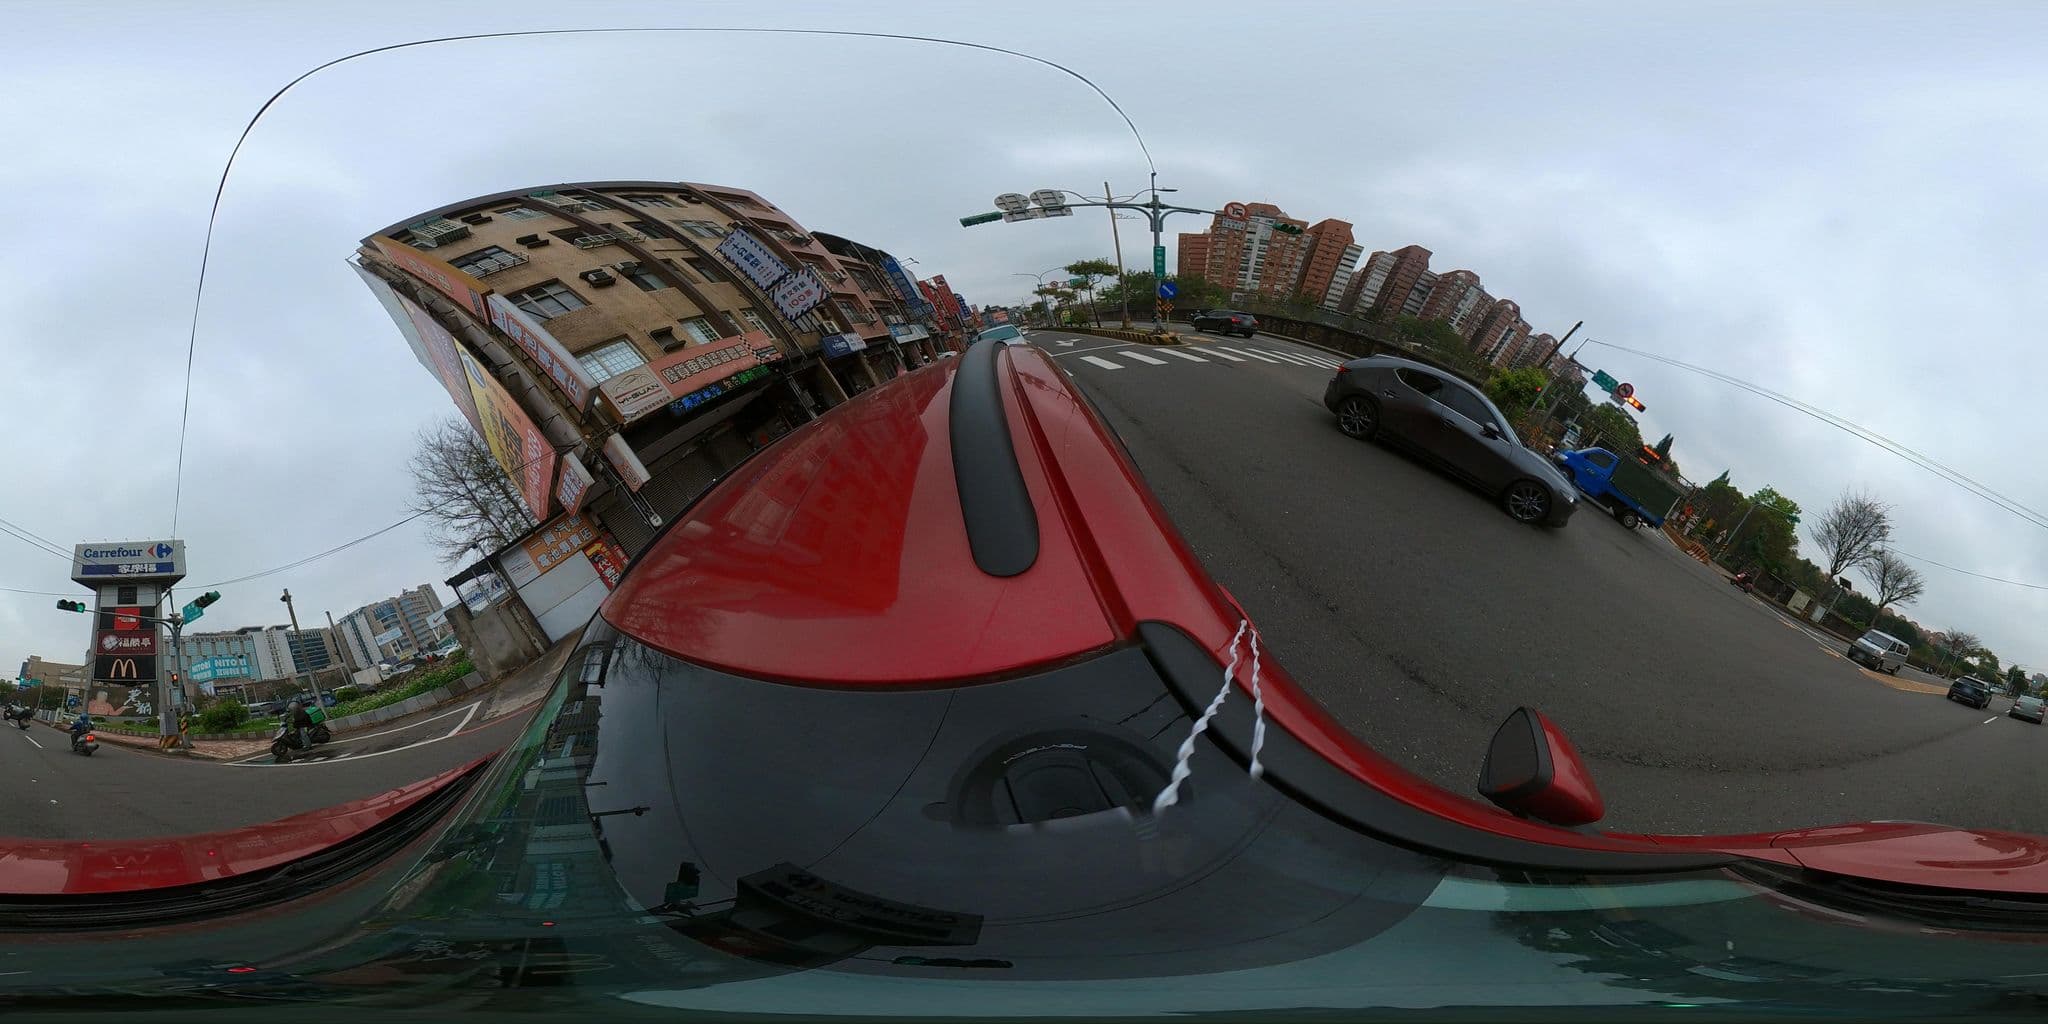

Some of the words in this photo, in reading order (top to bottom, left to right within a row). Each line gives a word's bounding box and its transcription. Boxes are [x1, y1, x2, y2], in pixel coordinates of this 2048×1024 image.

[617, 383, 659, 405] YI-GUAN
[83, 546, 143, 559] Carrefour
[118, 563, 157, 574] 家樂福
